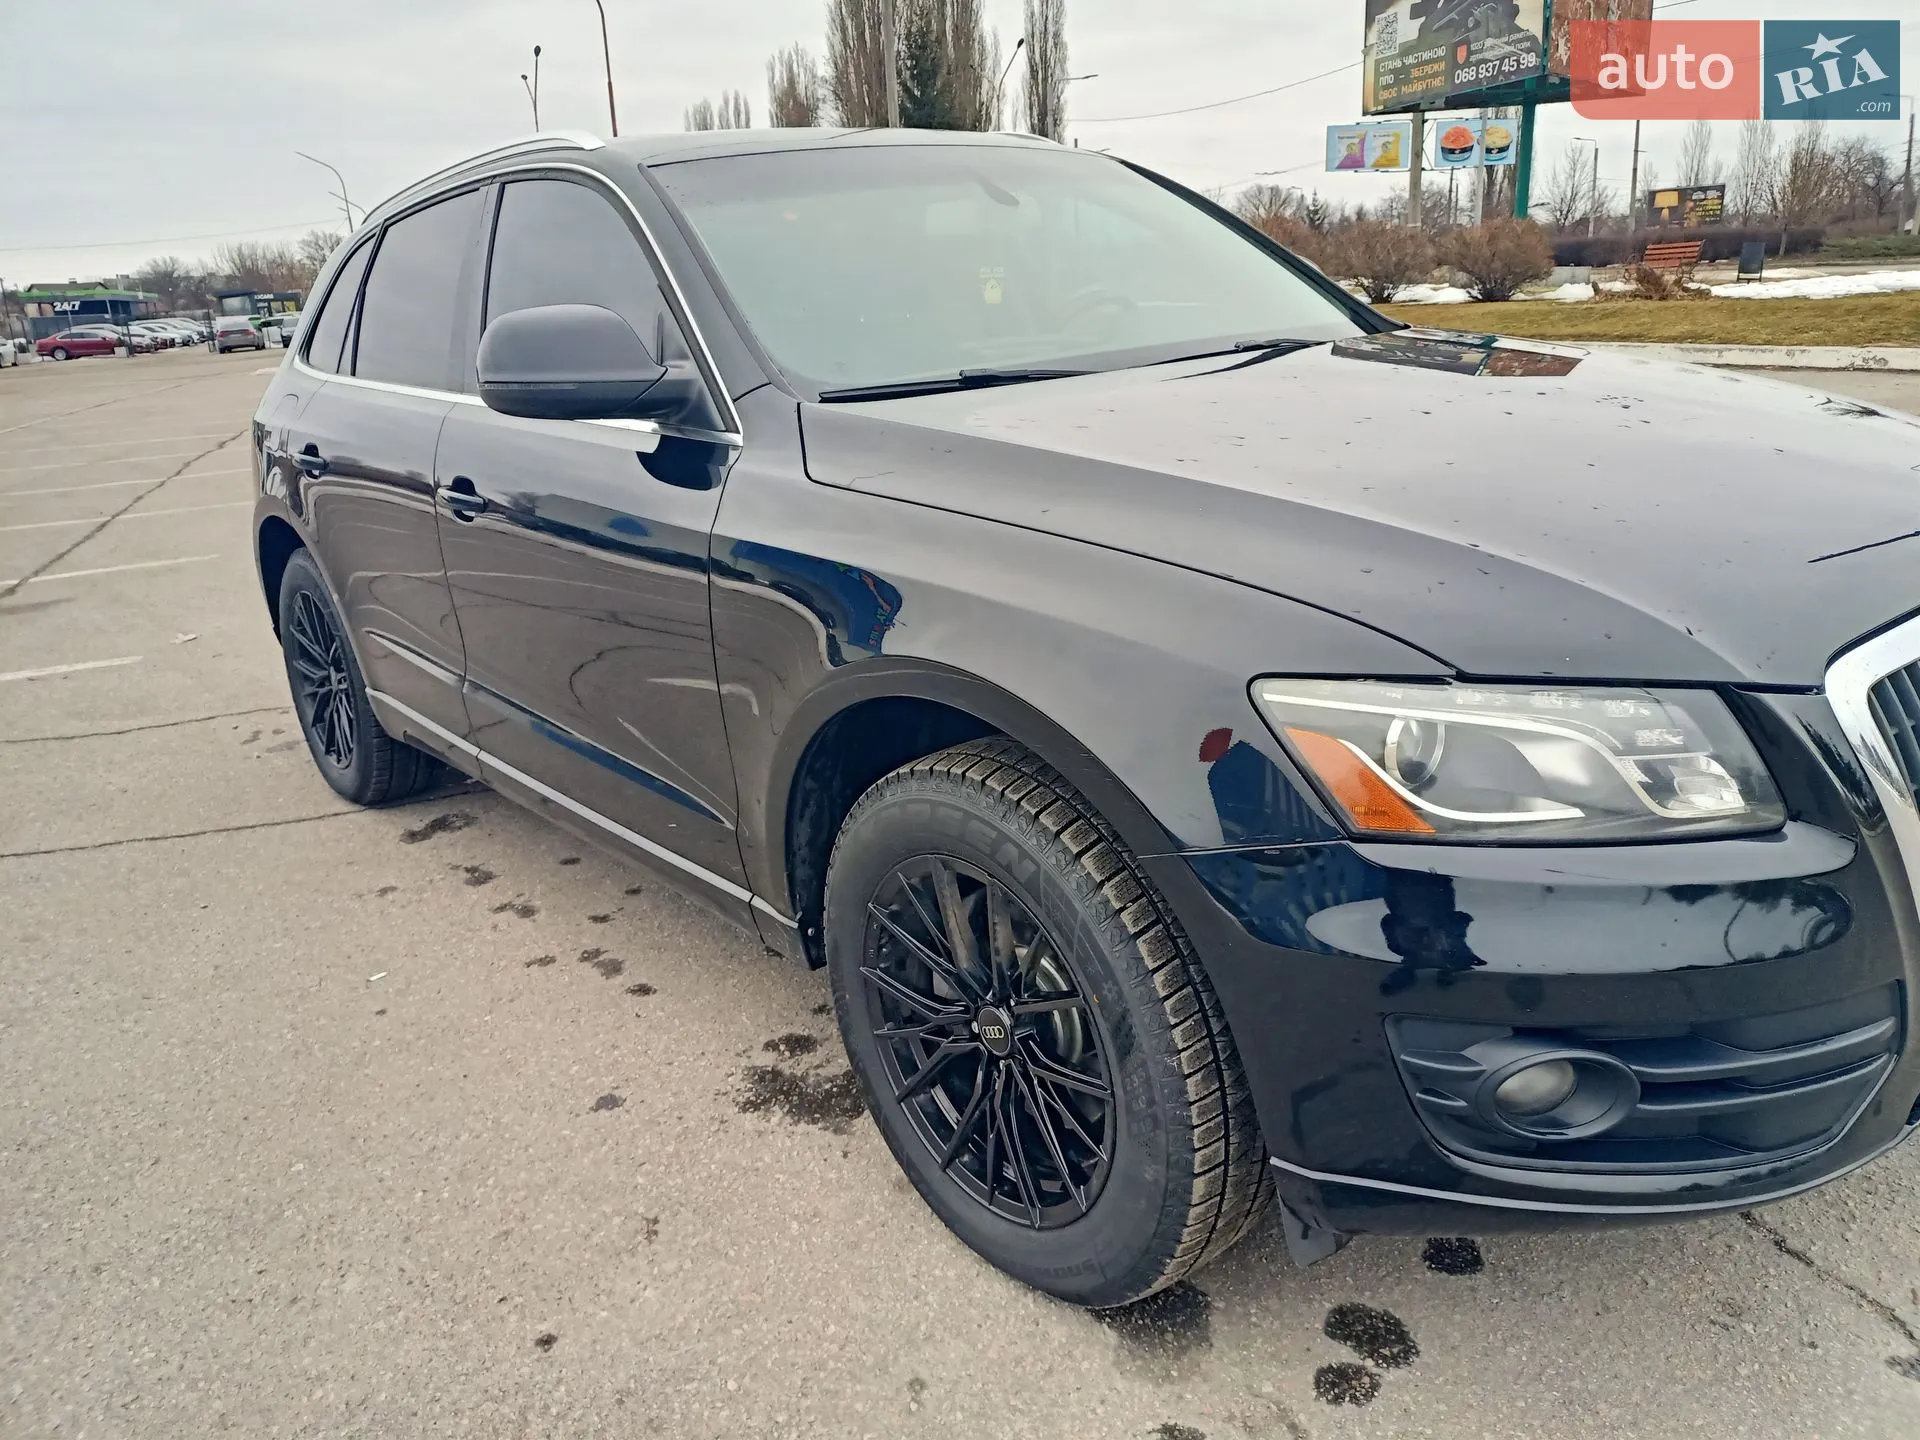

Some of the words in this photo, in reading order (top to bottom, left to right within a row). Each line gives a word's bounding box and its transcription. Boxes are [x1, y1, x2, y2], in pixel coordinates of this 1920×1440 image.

[1379, 60, 1403, 73] СТАНЬ
[1403, 45, 1447, 65] ЧАСТИНОЮ
[1454, 66, 1475, 84] 068
[1478, 58, 1499, 78] 937
[1501, 54, 1518, 74] 45
[1518, 52, 1537, 69] 99
[1379, 73, 1395, 87] ППО
[1409, 61, 1446, 78] ЗБЕРЕЖИ
[53, 300, 80, 312] 24/7
